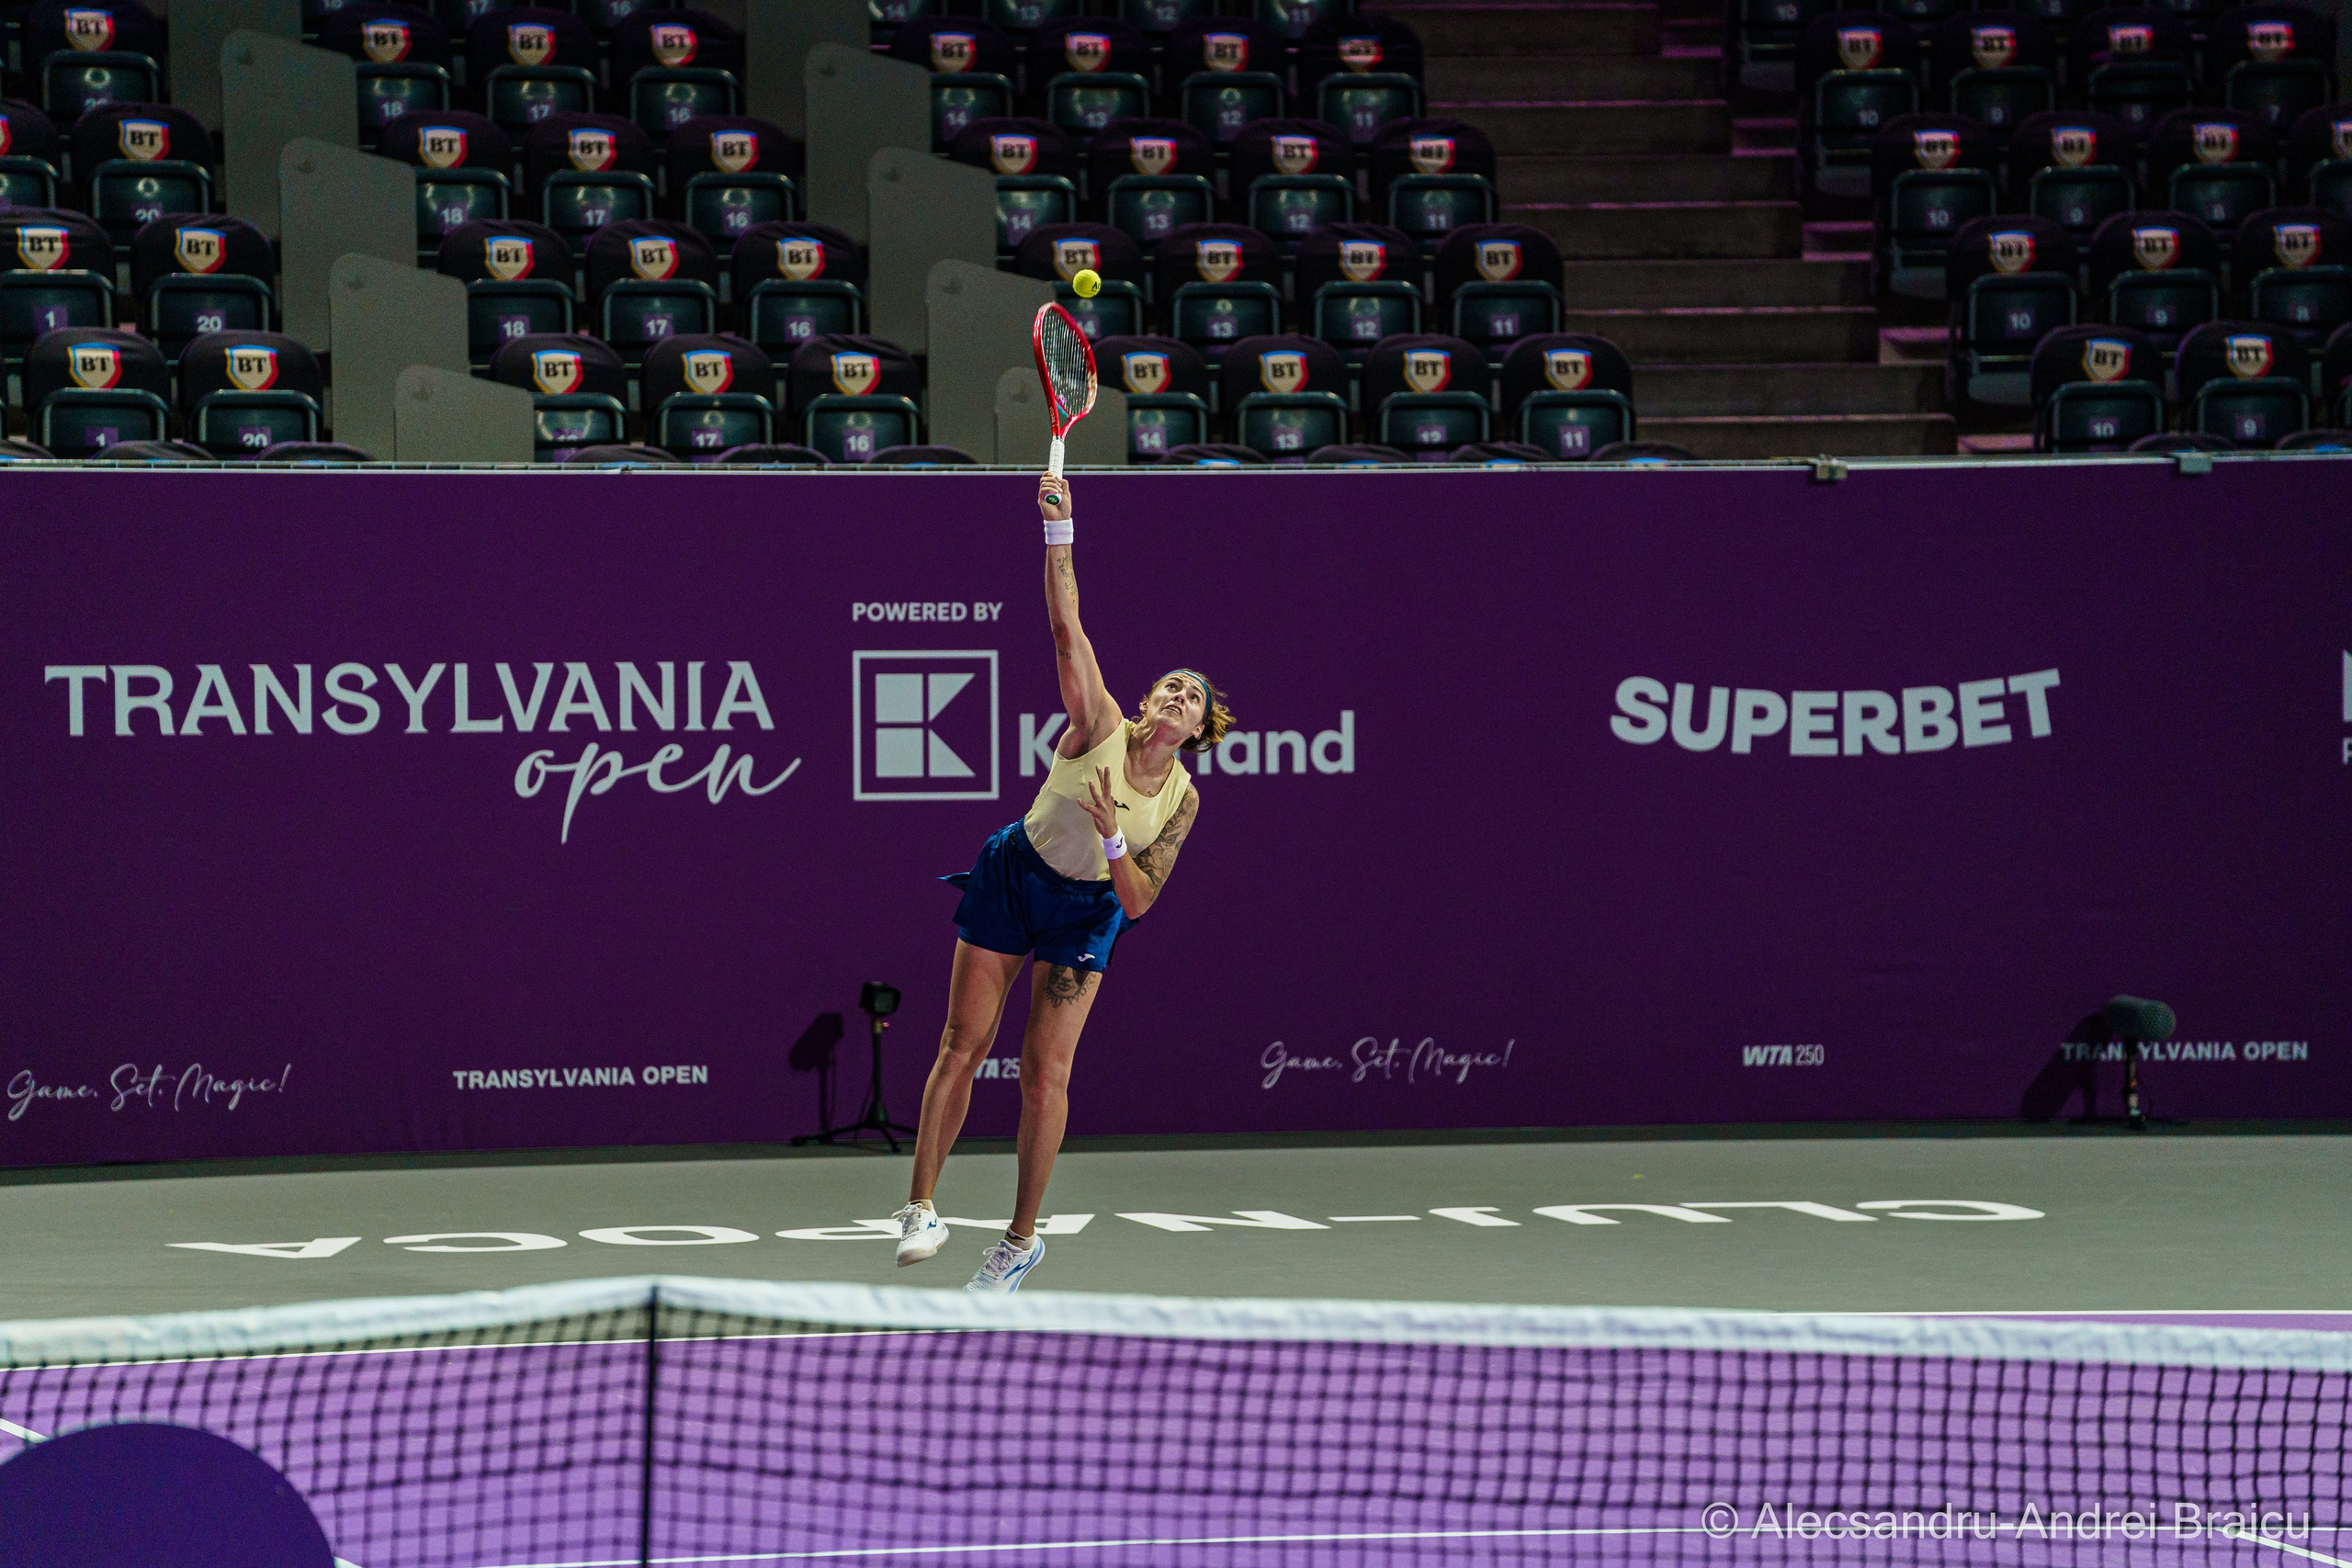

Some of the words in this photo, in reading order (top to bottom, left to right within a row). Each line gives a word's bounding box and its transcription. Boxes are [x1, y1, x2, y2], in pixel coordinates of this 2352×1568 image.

[77, 18, 105, 35] BT
[373, 31, 399, 46] BT
[520, 35, 546, 50] BT
[662, 35, 687, 50] BT
[529, 103, 551, 119] 17
[946, 110, 968, 127] 14
[1220, 110, 1242, 125] 12
[1352, 112, 1374, 127] 11
[129, 130, 160, 146] BT
[430, 137, 456, 152] BT
[579, 140, 606, 154] BT
[722, 141, 748, 156] BT
[1001, 143, 1027, 160] BT
[1141, 145, 1165, 160] BT
[1283, 143, 1308, 160] BT
[441, 206, 463, 224] 18
[584, 209, 606, 226] 17
[726, 211, 748, 228] 16
[1011, 215, 1031, 230] 14
[1147, 213, 1169, 230] 13
[1288, 213, 1310, 230] 12
[1428, 213, 1448, 230] 11
[1929, 209, 1950, 228] 10
[29, 236, 59, 252] BT
[187, 239, 215, 255] BT
[2144, 237, 2170, 254] BT
[496, 248, 524, 263] BT
[641, 248, 667, 264] BT
[788, 248, 814, 265] BT
[1064, 250, 1091, 265] BT
[1207, 250, 1233, 265] BT
[1351, 250, 1376, 265] BT
[1487, 250, 1514, 266] BT
[44, 310, 57, 329] 1
[197, 314, 222, 333] 20
[645, 320, 668, 336] 17
[1494, 320, 1514, 336] 11
[2010, 312, 2030, 331] 10
[503, 320, 526, 337] 18
[788, 321, 810, 338] 16
[1211, 321, 1233, 338] 13
[1354, 321, 1378, 336] 12
[2095, 349, 2122, 367] BT
[2236, 345, 2264, 364] BT
[81, 356, 110, 373] BT
[237, 356, 266, 373] BT
[544, 362, 573, 378] BT
[695, 362, 722, 378] BT
[843, 362, 871, 378] BT
[1134, 362, 1161, 378] BT
[1272, 362, 1299, 378] BT
[1413, 360, 1441, 377] BT
[1555, 360, 1582, 375] BT
[2243, 417, 2256, 437] 9
[695, 434, 718, 448] 17
[847, 435, 870, 452] 16
[1137, 432, 1161, 450] 14
[1275, 434, 1299, 450] 13
[1564, 432, 1584, 448] 11
[853, 602, 968, 622] POWERED
[973, 602, 1003, 621] BY
[44, 661, 775, 737] TRANSYLVANIA
[1609, 667, 2061, 756] SUPERBET
[1019, 709, 1354, 776] Kand
[514, 742, 802, 844] open
[2062, 1041, 2236, 1062] TRANYLVANIA
[2243, 1040, 2309, 1062] OPEN
[974, 1058, 1000, 1079] TA
[1001, 1058, 1020, 1079] 25
[1408, 1036, 1515, 1084] Magic!
[175, 1062, 292, 1111] Magic!
[453, 1066, 636, 1090] TRANSYLVANIA
[642, 1066, 708, 1086] OPEN
